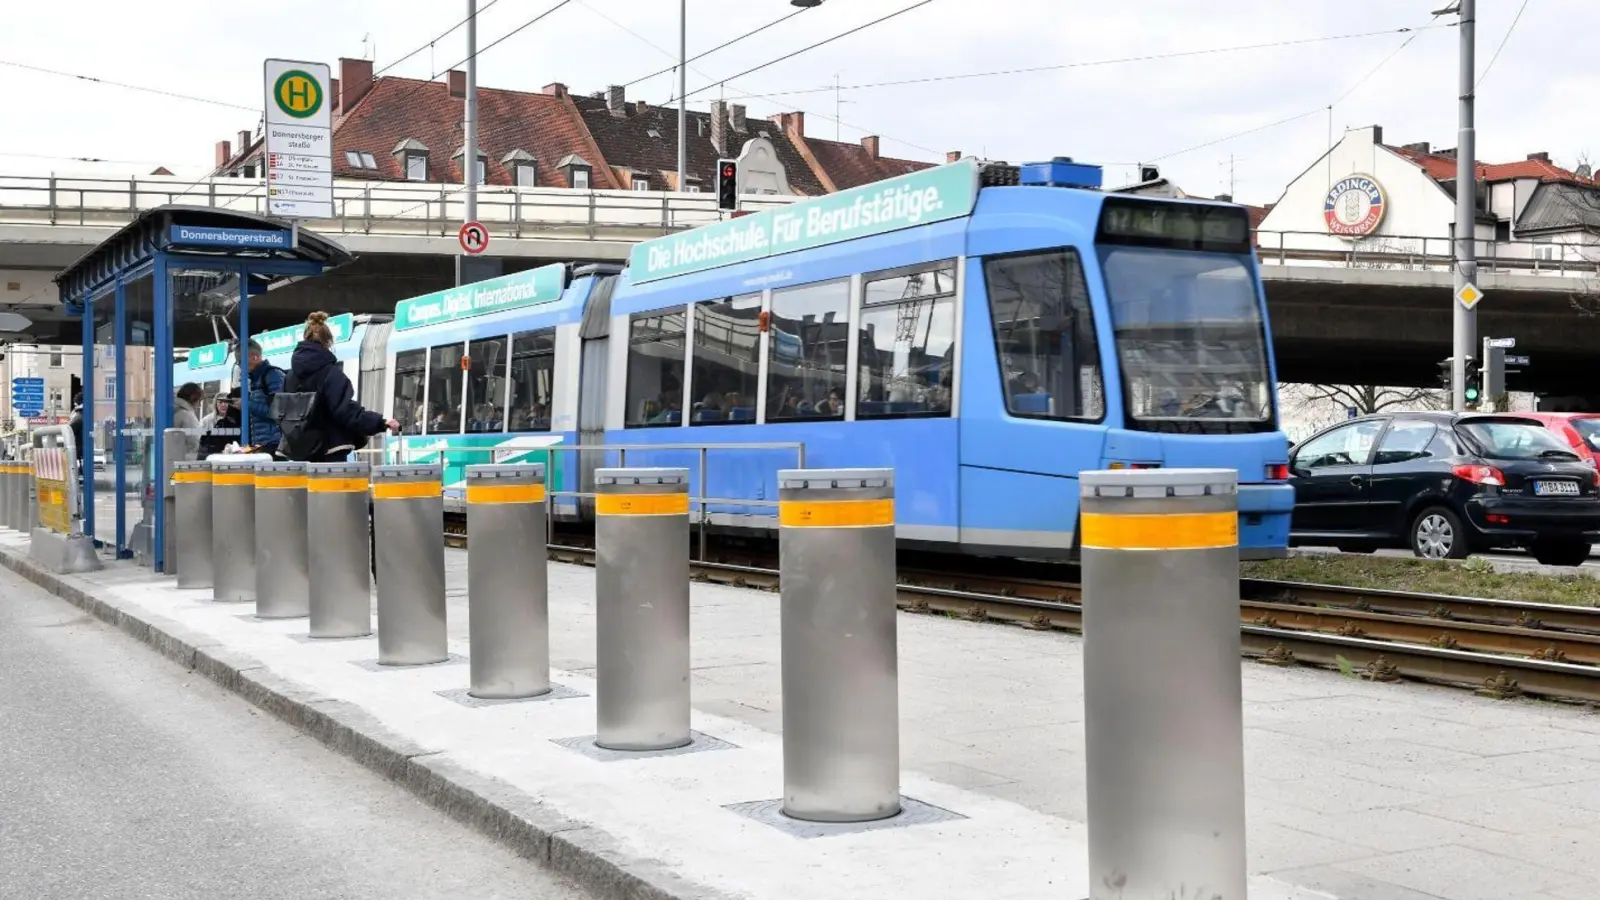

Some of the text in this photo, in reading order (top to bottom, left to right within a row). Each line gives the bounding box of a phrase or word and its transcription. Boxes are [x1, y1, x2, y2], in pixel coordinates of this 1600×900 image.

[289, 80, 309, 108] H
[1326, 179, 1379, 205] ERDINGER
[180, 229, 284, 244] Donnersbergerstraße
[648, 185, 944, 272] Die Hochschule. Für Berufstätige.
[474, 275, 538, 309] International.
